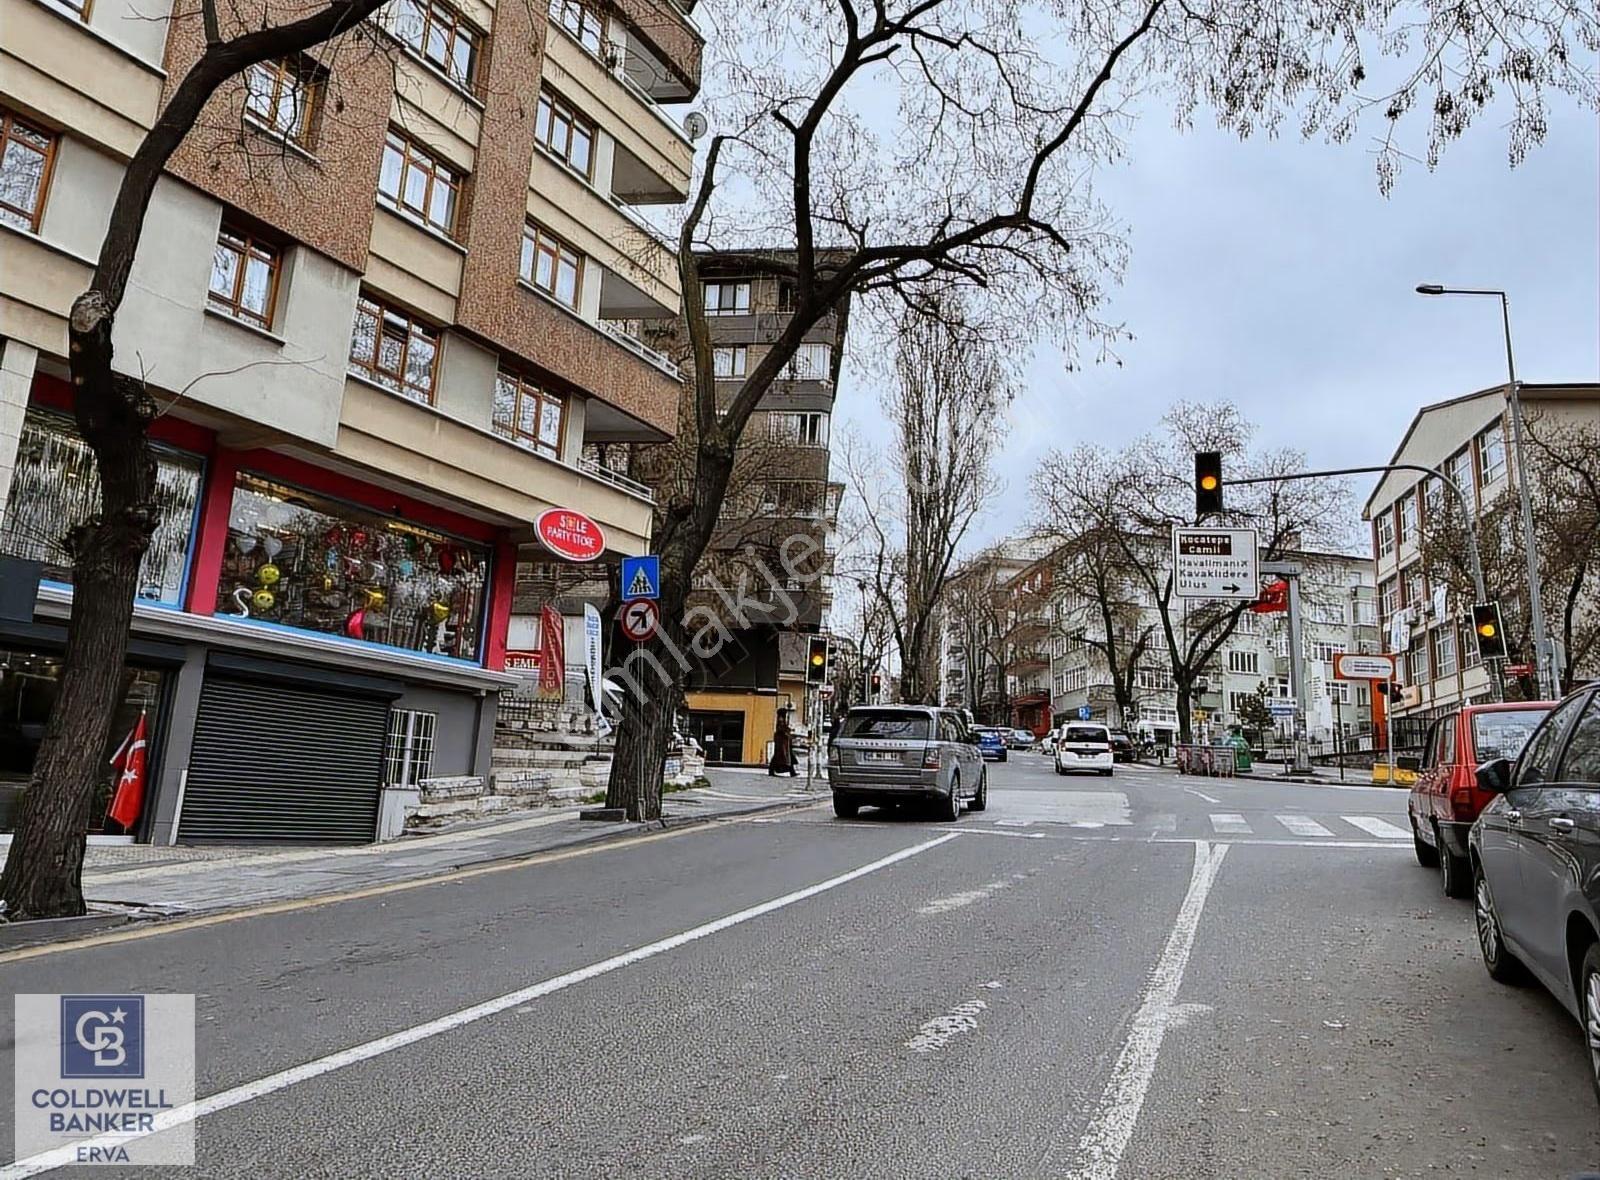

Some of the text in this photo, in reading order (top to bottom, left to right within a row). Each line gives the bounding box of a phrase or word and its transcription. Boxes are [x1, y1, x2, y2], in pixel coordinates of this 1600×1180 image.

[546, 526, 596, 549] PARTY STORE
[1180, 536, 1230, 545] Kocatepe
[1180, 580, 1207, 589] Ulus
[513, 657, 541, 669] EML
